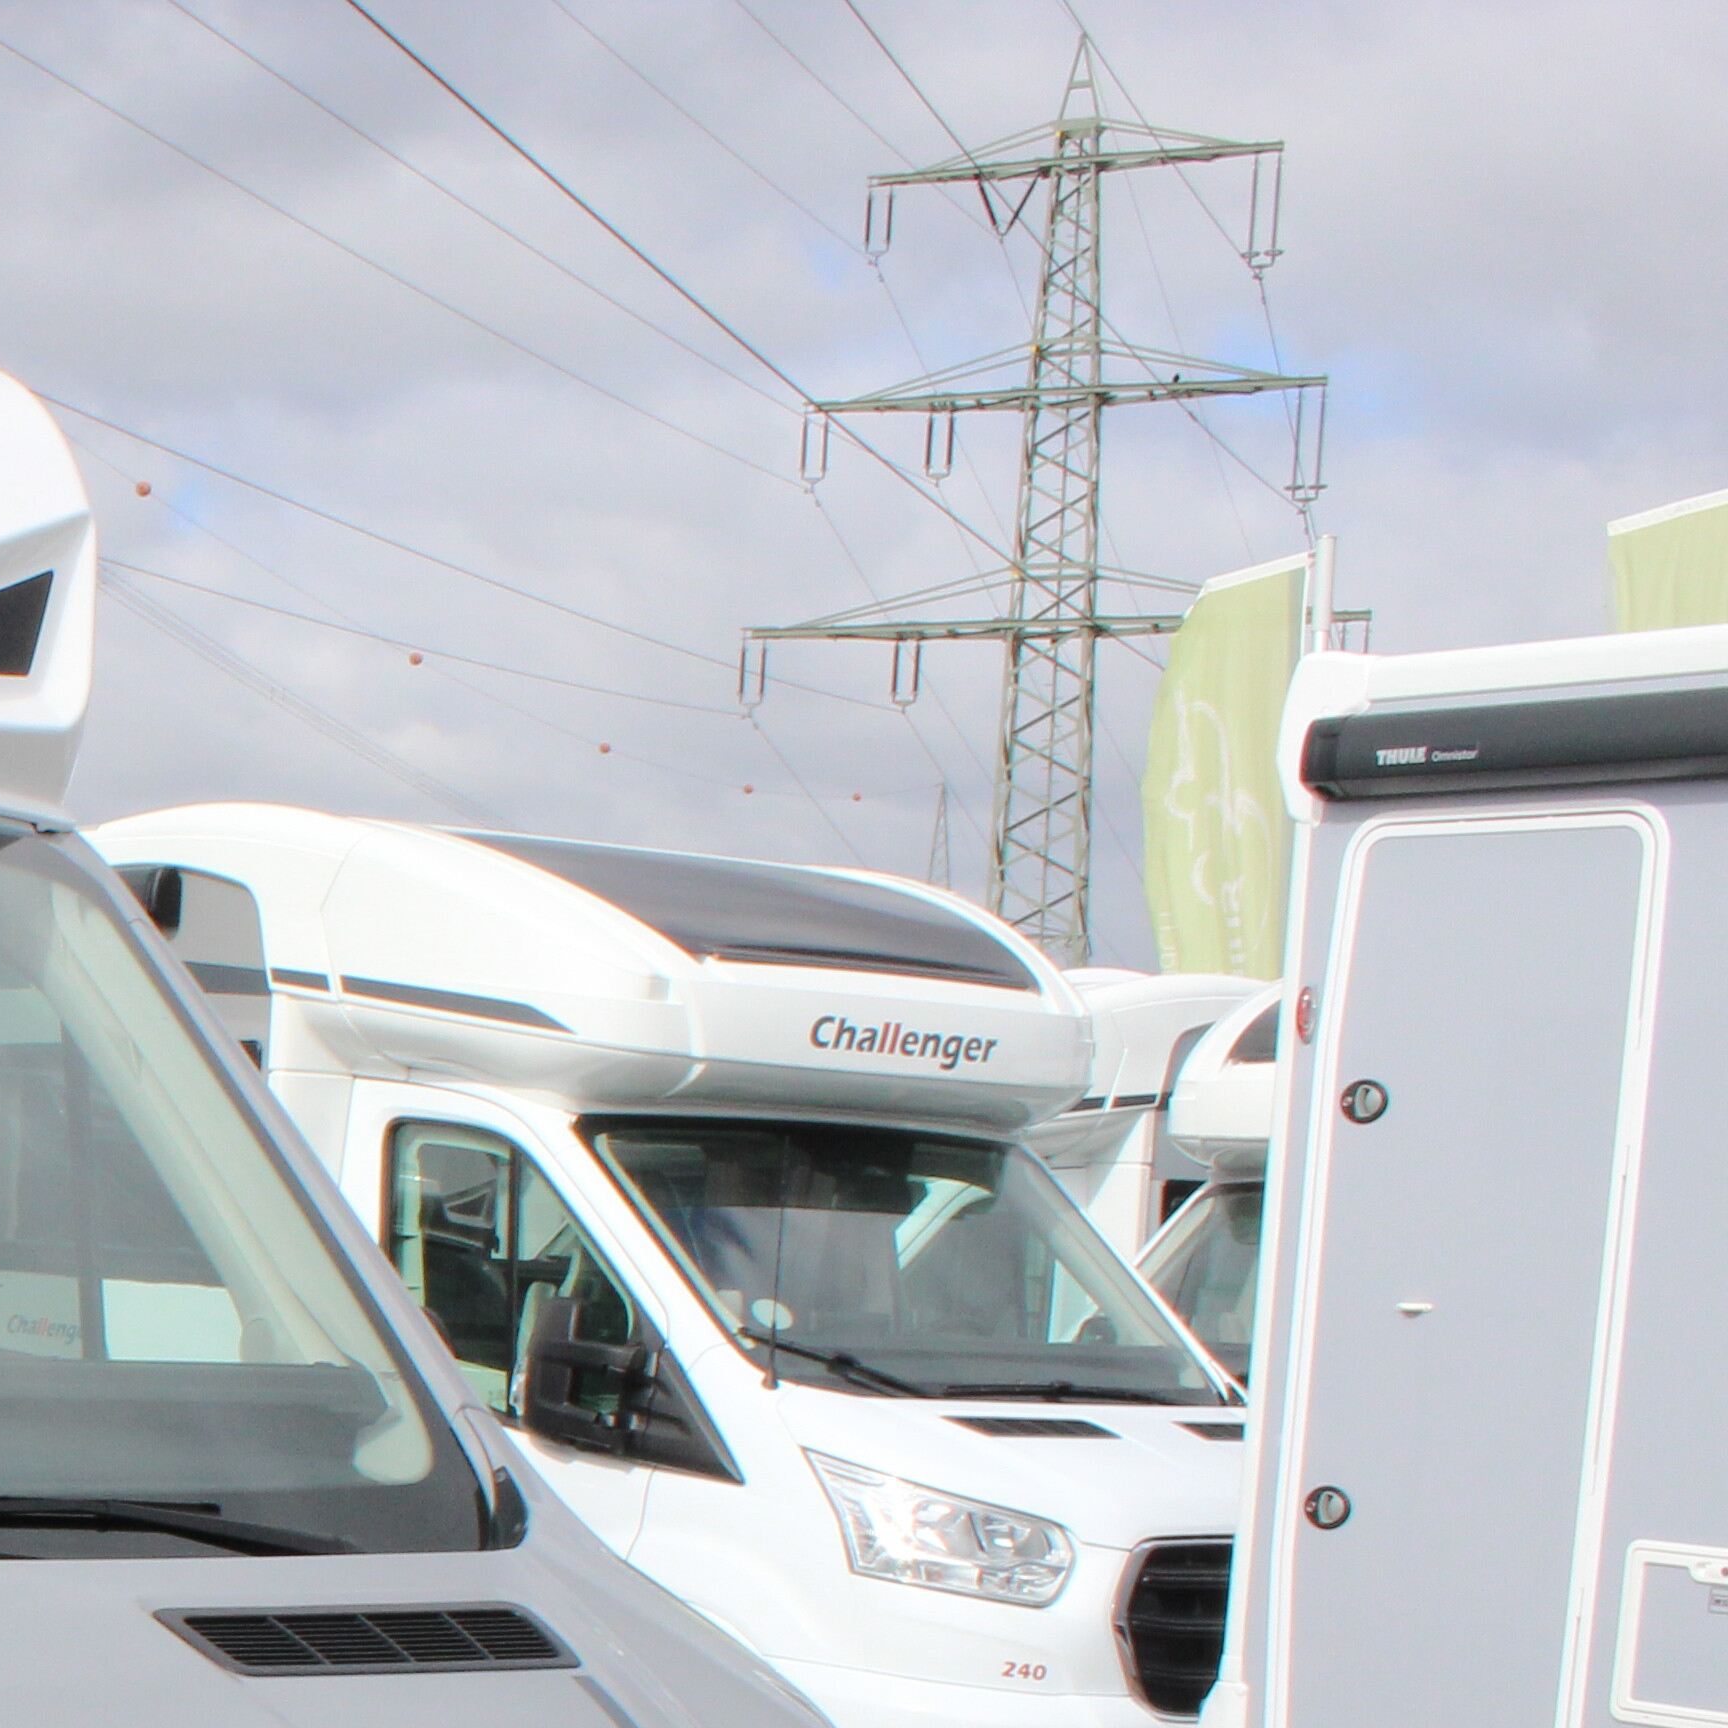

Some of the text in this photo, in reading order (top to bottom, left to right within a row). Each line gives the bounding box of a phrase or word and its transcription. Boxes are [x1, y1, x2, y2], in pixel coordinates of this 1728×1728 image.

[1376, 746, 1428, 766] THULE
[809, 1015, 998, 1070] Challenger
[1002, 1661, 1047, 1681] 240
